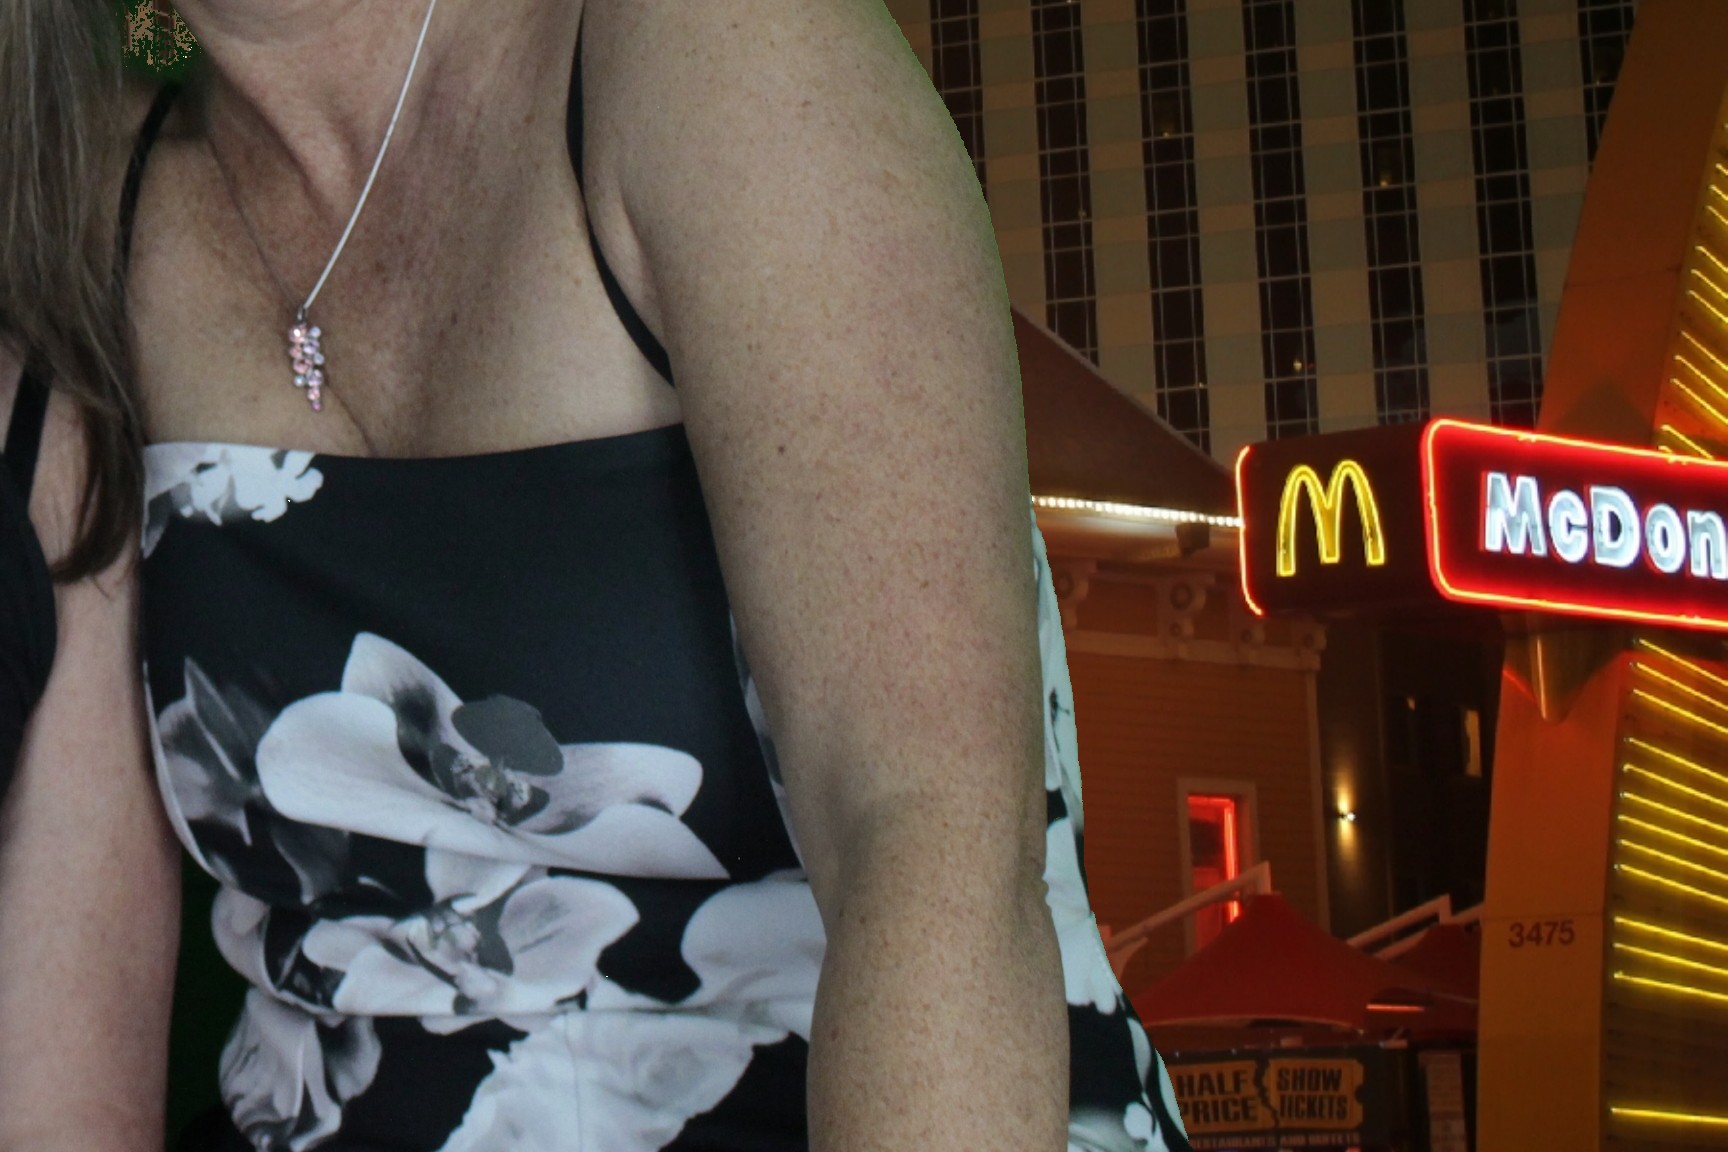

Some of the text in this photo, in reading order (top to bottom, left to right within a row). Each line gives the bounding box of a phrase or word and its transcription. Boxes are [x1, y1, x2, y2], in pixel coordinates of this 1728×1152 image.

[1507, 919, 1576, 948] 3475
[1176, 1066, 1342, 1098] HALF SHOW
[1279, 1094, 1348, 1121] TICKETS
